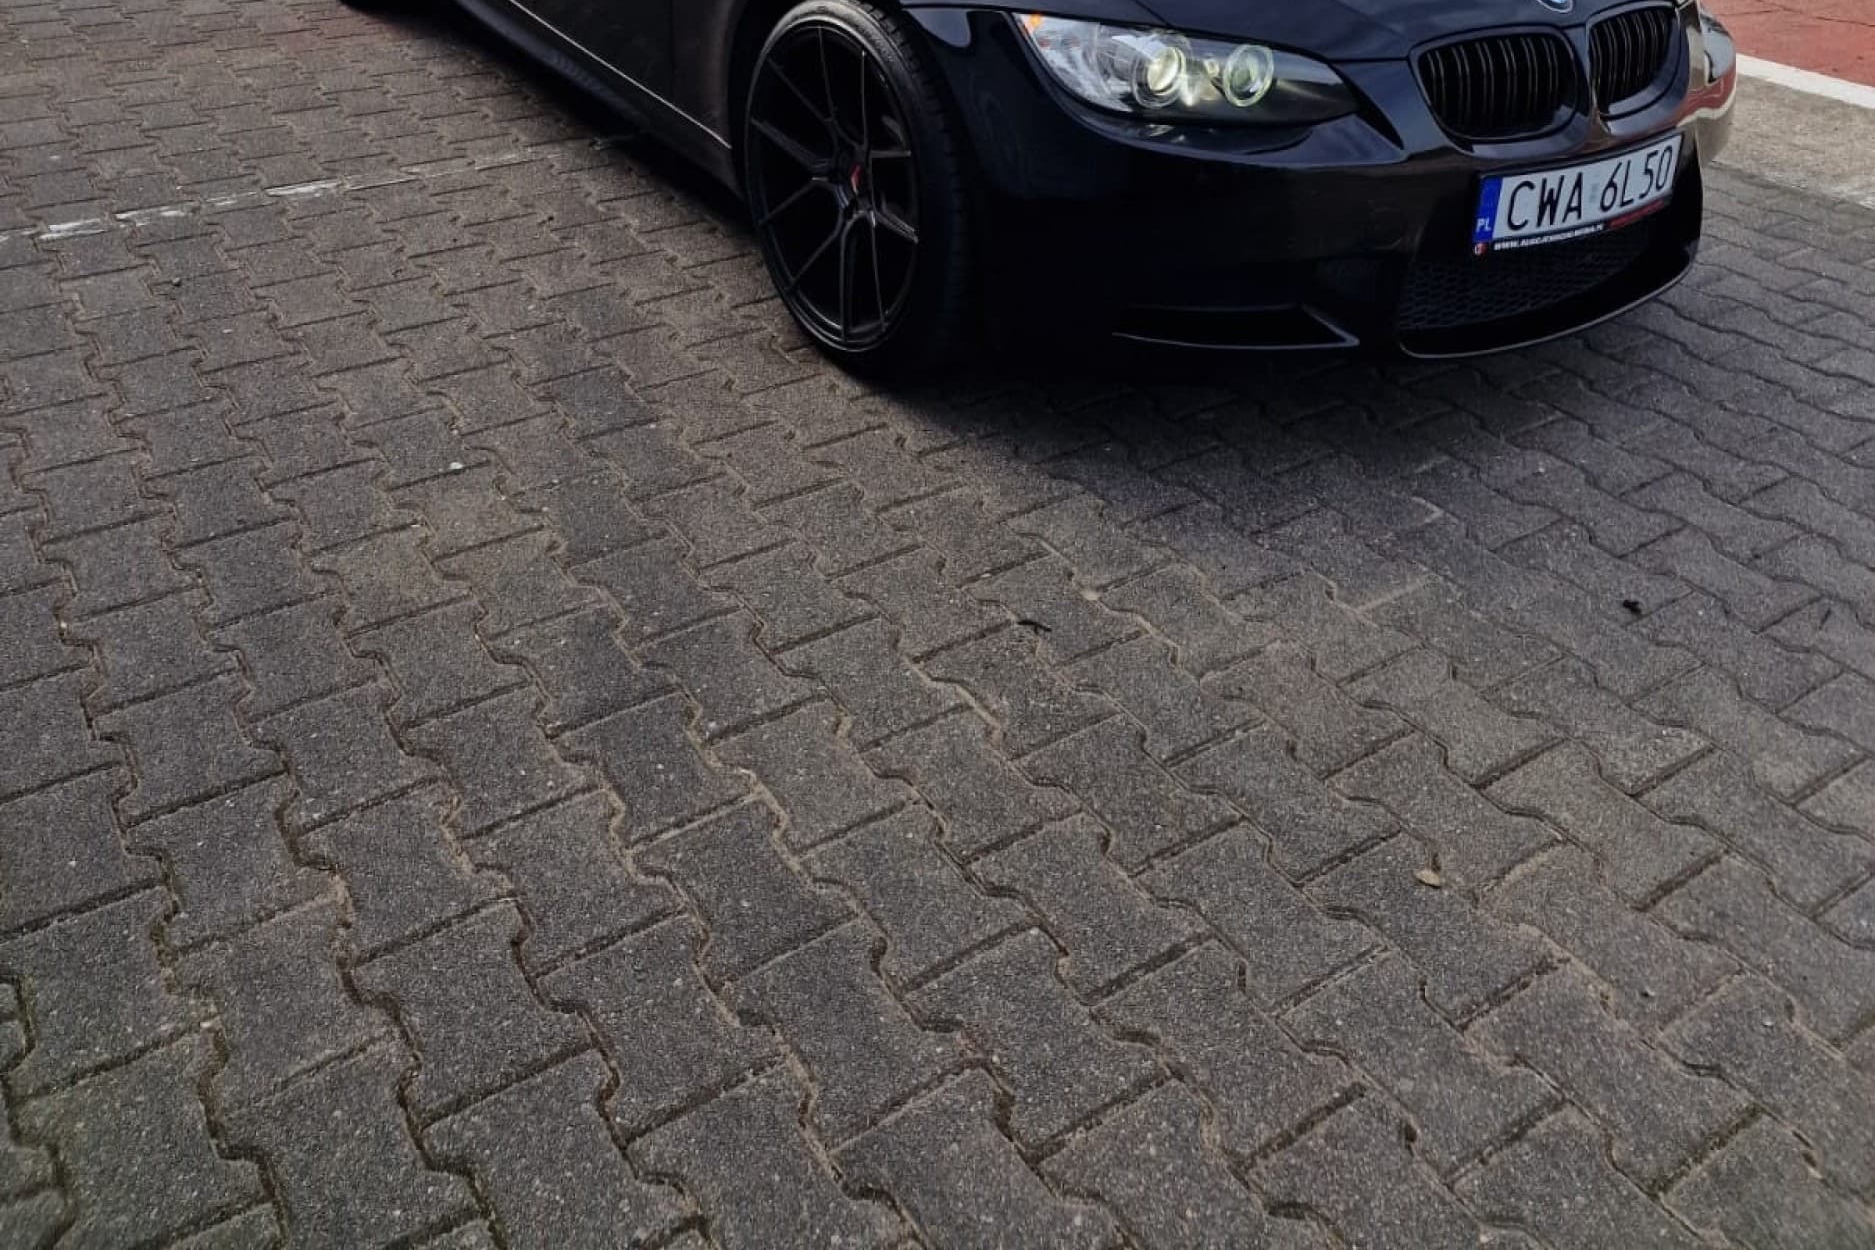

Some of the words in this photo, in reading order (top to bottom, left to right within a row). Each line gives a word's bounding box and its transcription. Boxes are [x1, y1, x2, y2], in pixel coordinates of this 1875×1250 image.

[1508, 172, 1584, 230] CWA
[1601, 146, 1673, 212] 6L50
[1475, 218, 1491, 233] PL
